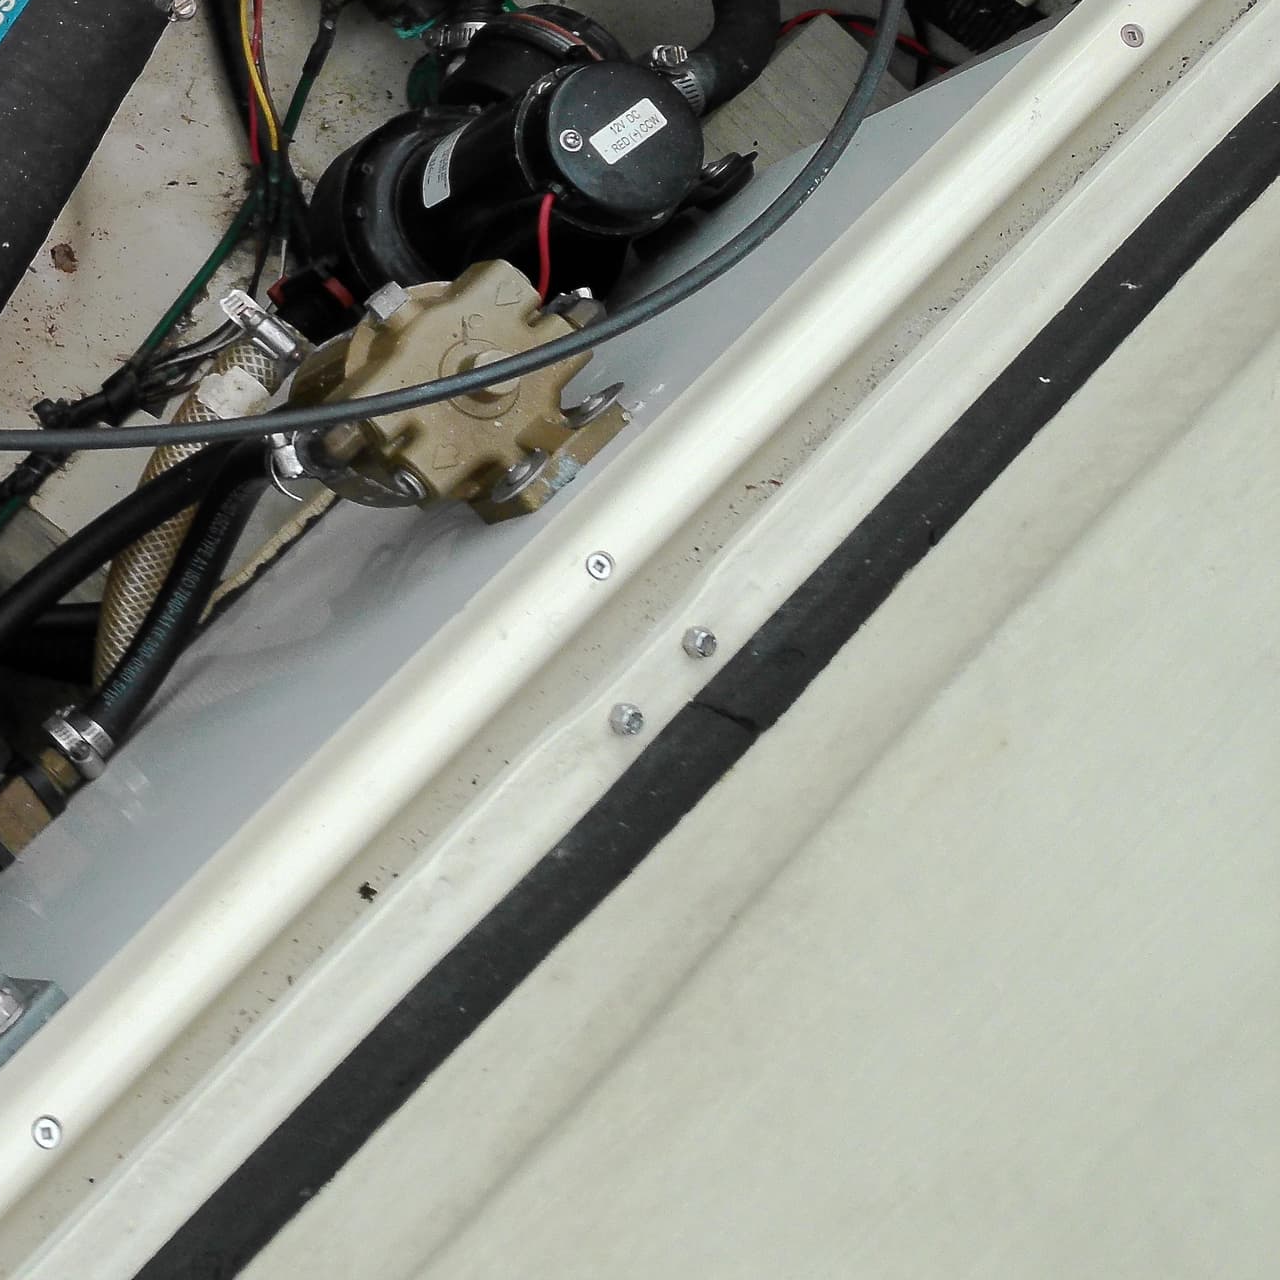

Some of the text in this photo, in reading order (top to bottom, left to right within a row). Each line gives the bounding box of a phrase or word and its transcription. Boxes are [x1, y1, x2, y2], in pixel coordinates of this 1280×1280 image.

[610, 110, 640, 134] 12V DC
[611, 137, 630, 153] RED
